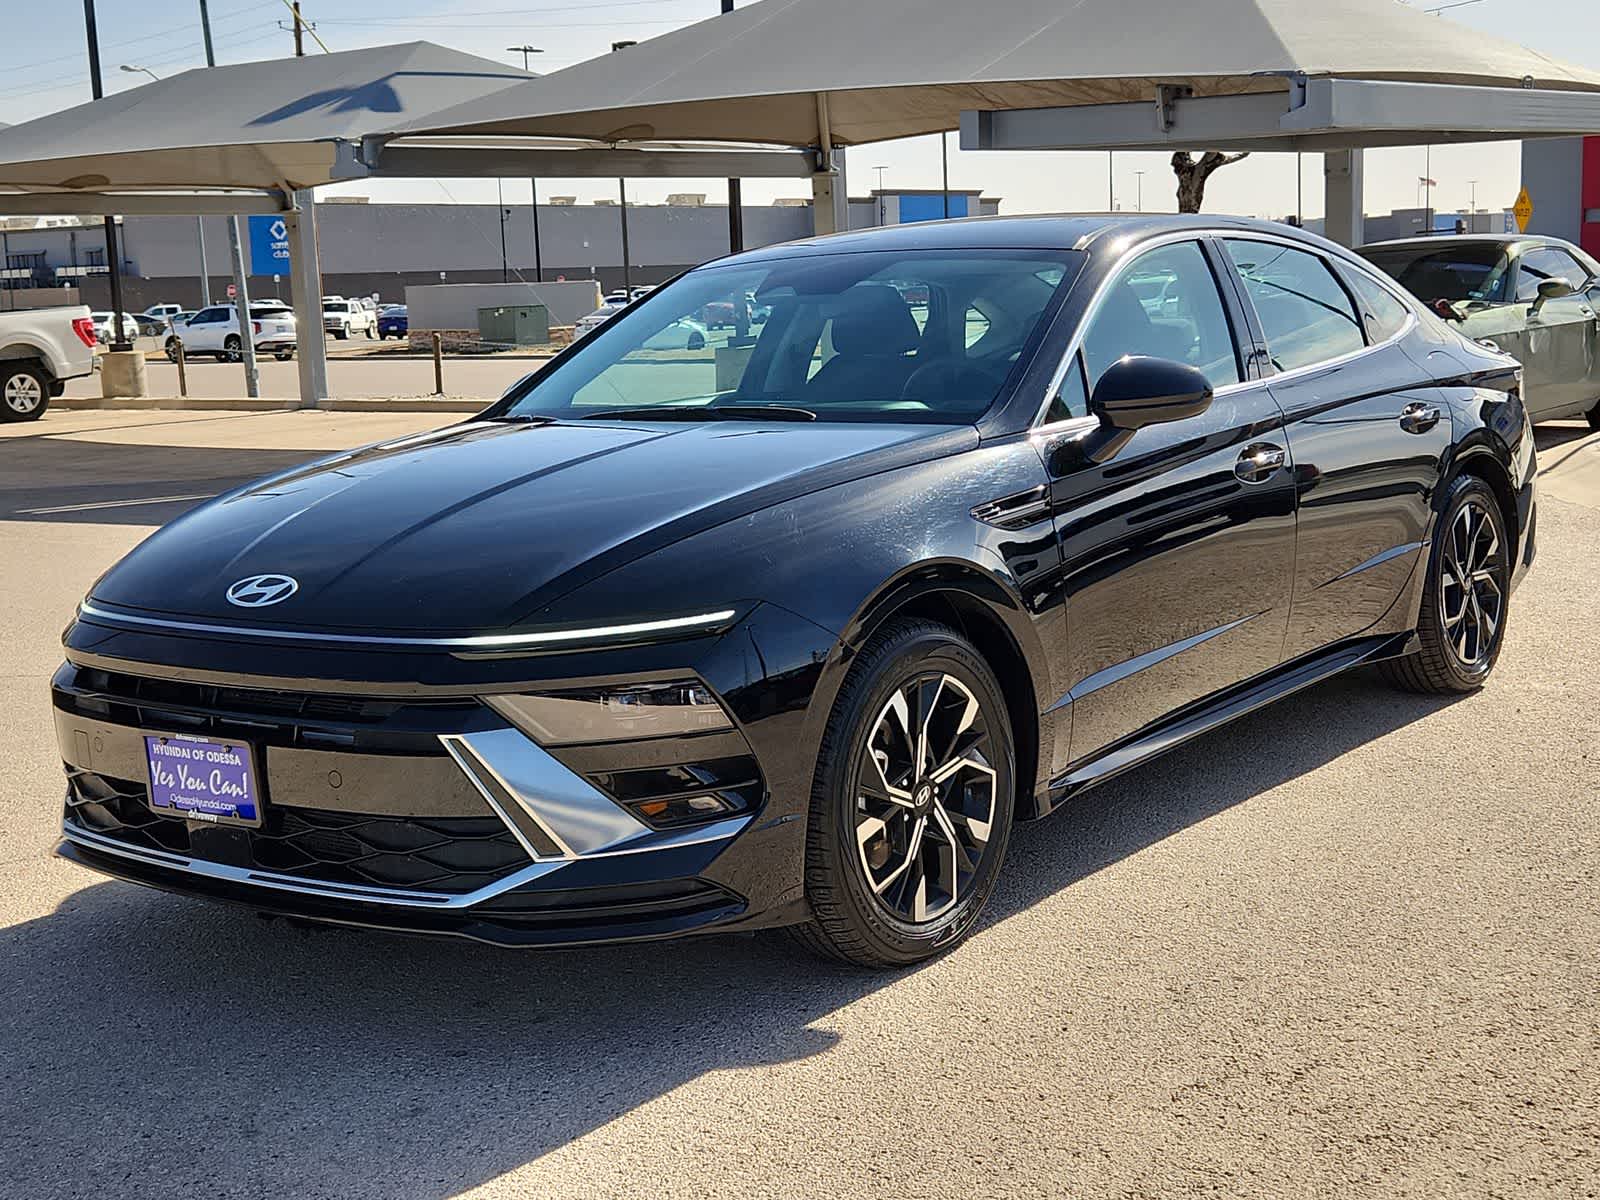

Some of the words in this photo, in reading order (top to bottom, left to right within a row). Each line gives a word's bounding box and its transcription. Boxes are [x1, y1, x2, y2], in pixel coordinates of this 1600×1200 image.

[152, 743, 191, 759] HYUNDAI
[192, 750, 205, 761] OF
[206, 751, 242, 766] ODESSA
[150, 760, 175, 788] Yes
[177, 764, 207, 791] You
[209, 769, 248, 799] Can!
[169, 793, 237, 811] OdessaHyundai.com
